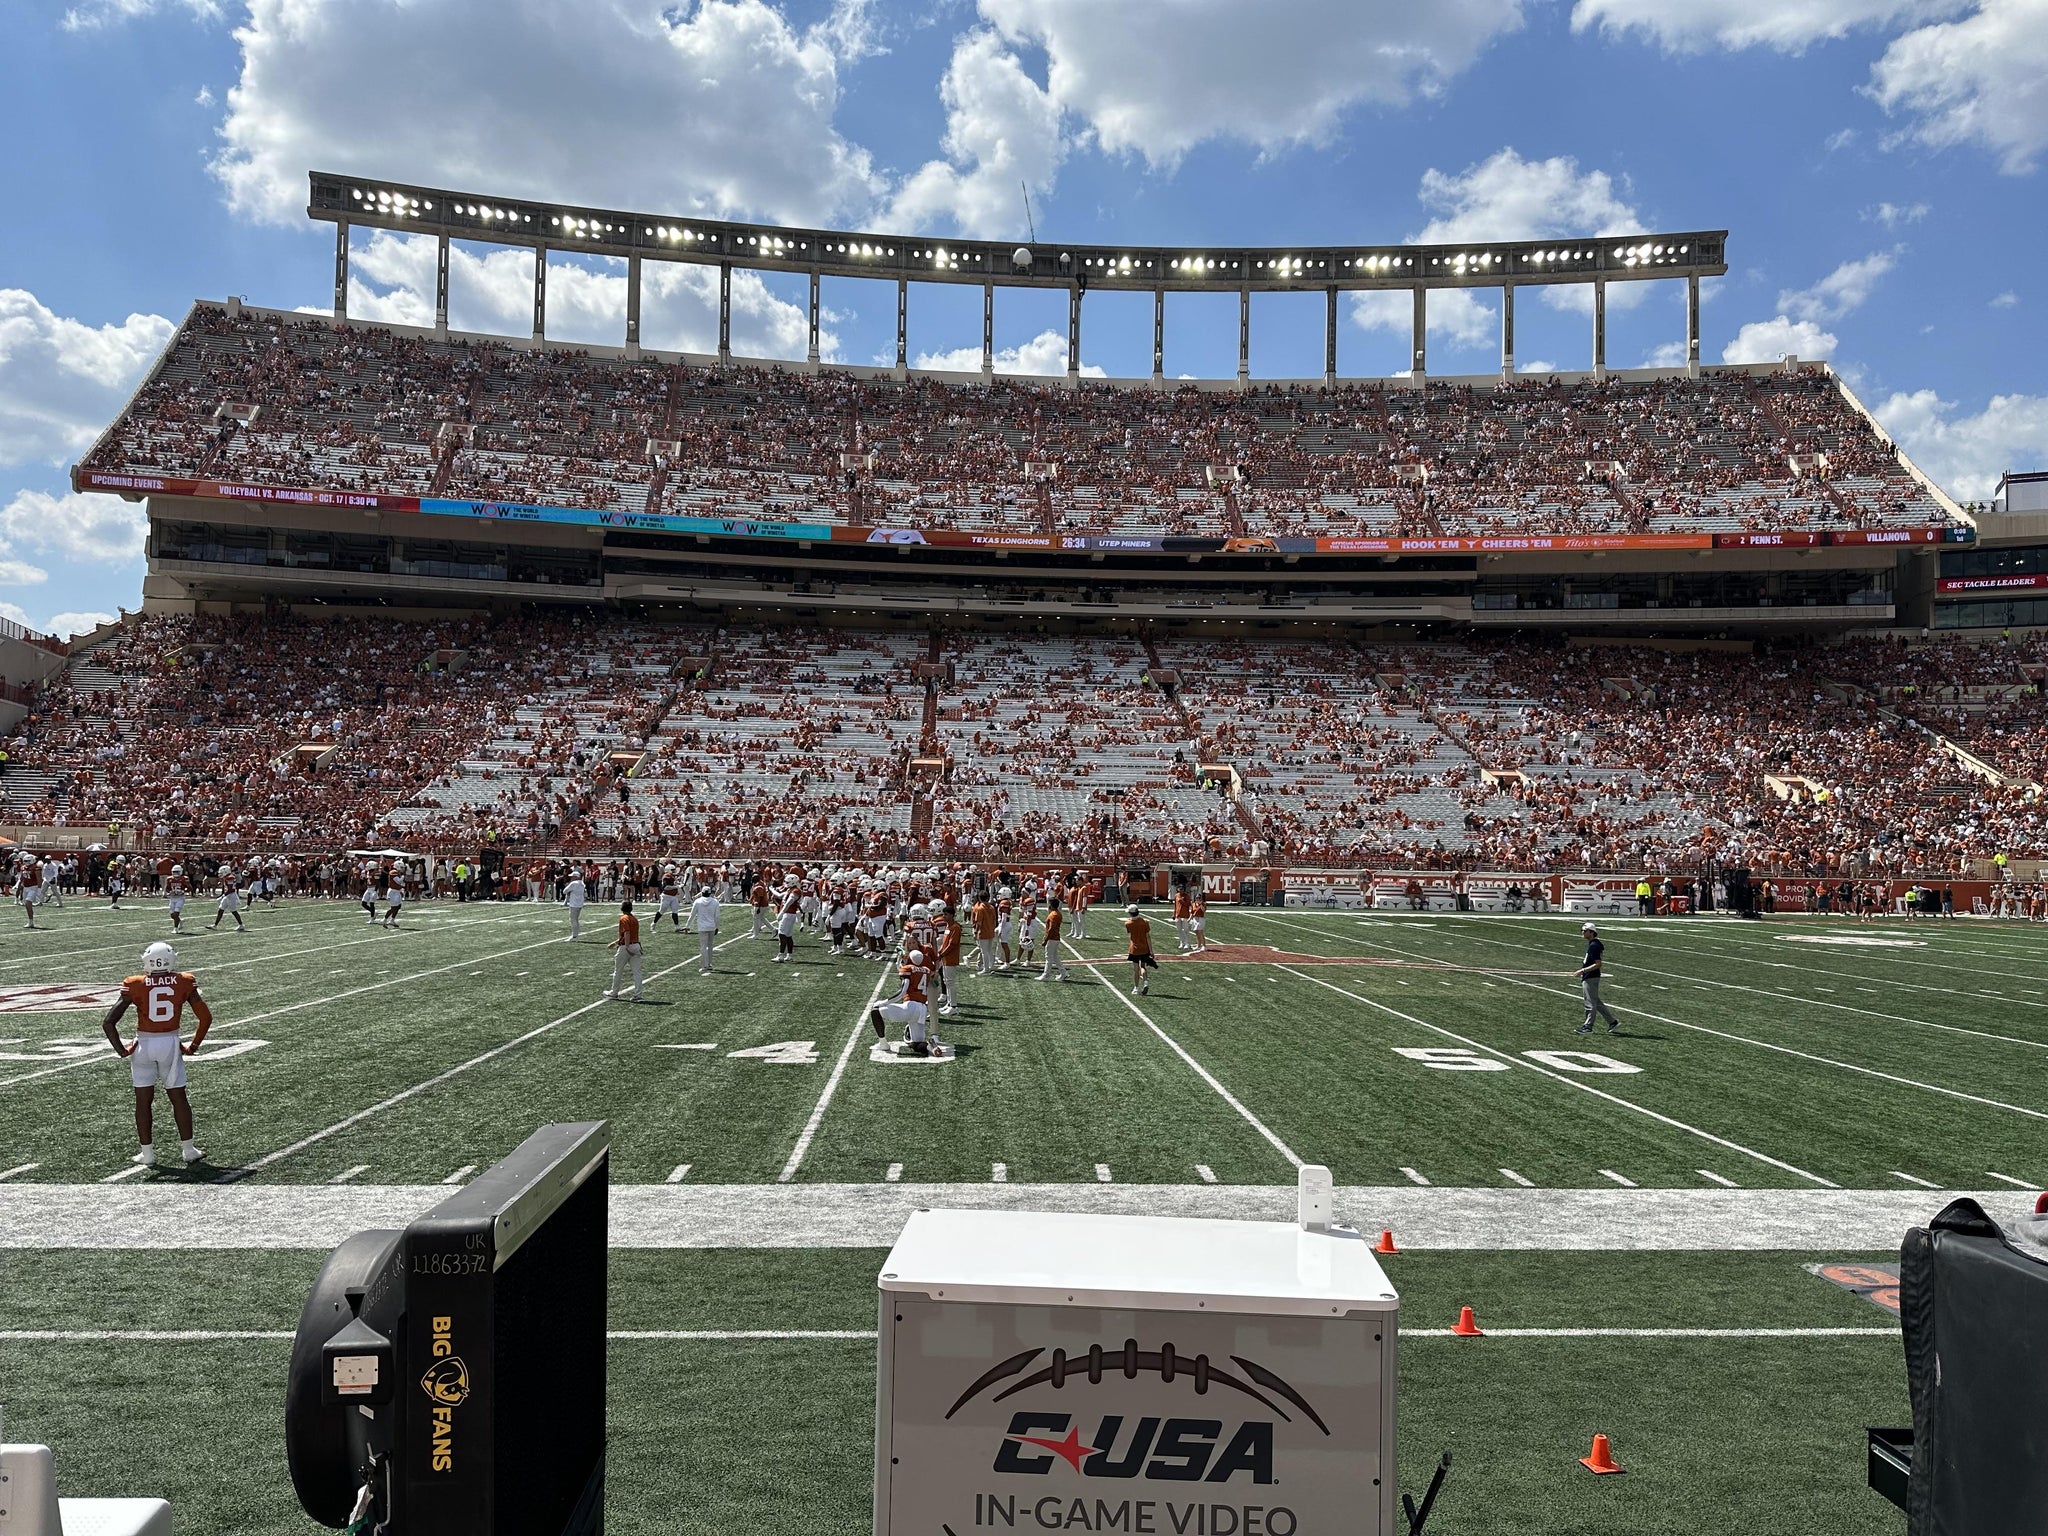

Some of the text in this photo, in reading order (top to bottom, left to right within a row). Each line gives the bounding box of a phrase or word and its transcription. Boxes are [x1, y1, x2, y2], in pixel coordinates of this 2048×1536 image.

[91, 475, 164, 490] UPCOMING EVENTS:
[219, 485, 261, 498] VOLLEYBALL
[262, 489, 274, 499] VS.
[275, 490, 313, 502] ARKANSAS
[319, 493, 335, 503] OCT.
[336, 495, 344, 504] 17
[348, 496, 365, 506] 6:30
[366, 497, 378, 507] PM
[471, 503, 510, 518] WOW
[600, 513, 637, 527] WOW
[722, 521, 759, 534] WOW
[971, 536, 1050, 546] TEXAS LONGHORNS
[1062, 537, 1086, 549] 26:34
[1564, 538, 1590, 548] Tito's
[1740, 535, 1814, 545] 2 PENN ST. 7
[1866, 532, 1910, 542] VILLANOVA
[1926, 532, 1934, 541] 0
[1402, 540, 1436, 548] HOOK
[1482, 540, 1528, 548] CHEERS
[1964, 580, 1996, 588] TACKLE
[1996, 578, 2036, 586] LEADERS
[156, 958, 162, 968] 6
[145, 976, 178, 986] BLACK
[148, 986, 174, 1022] 6
[412, 1253, 488, 1276] 11863372
[432, 1316, 452, 1358] BIG
[432, 1406, 452, 1472] FANS
[974, 1493, 1298, 1536] IN-GAME VIDEO
